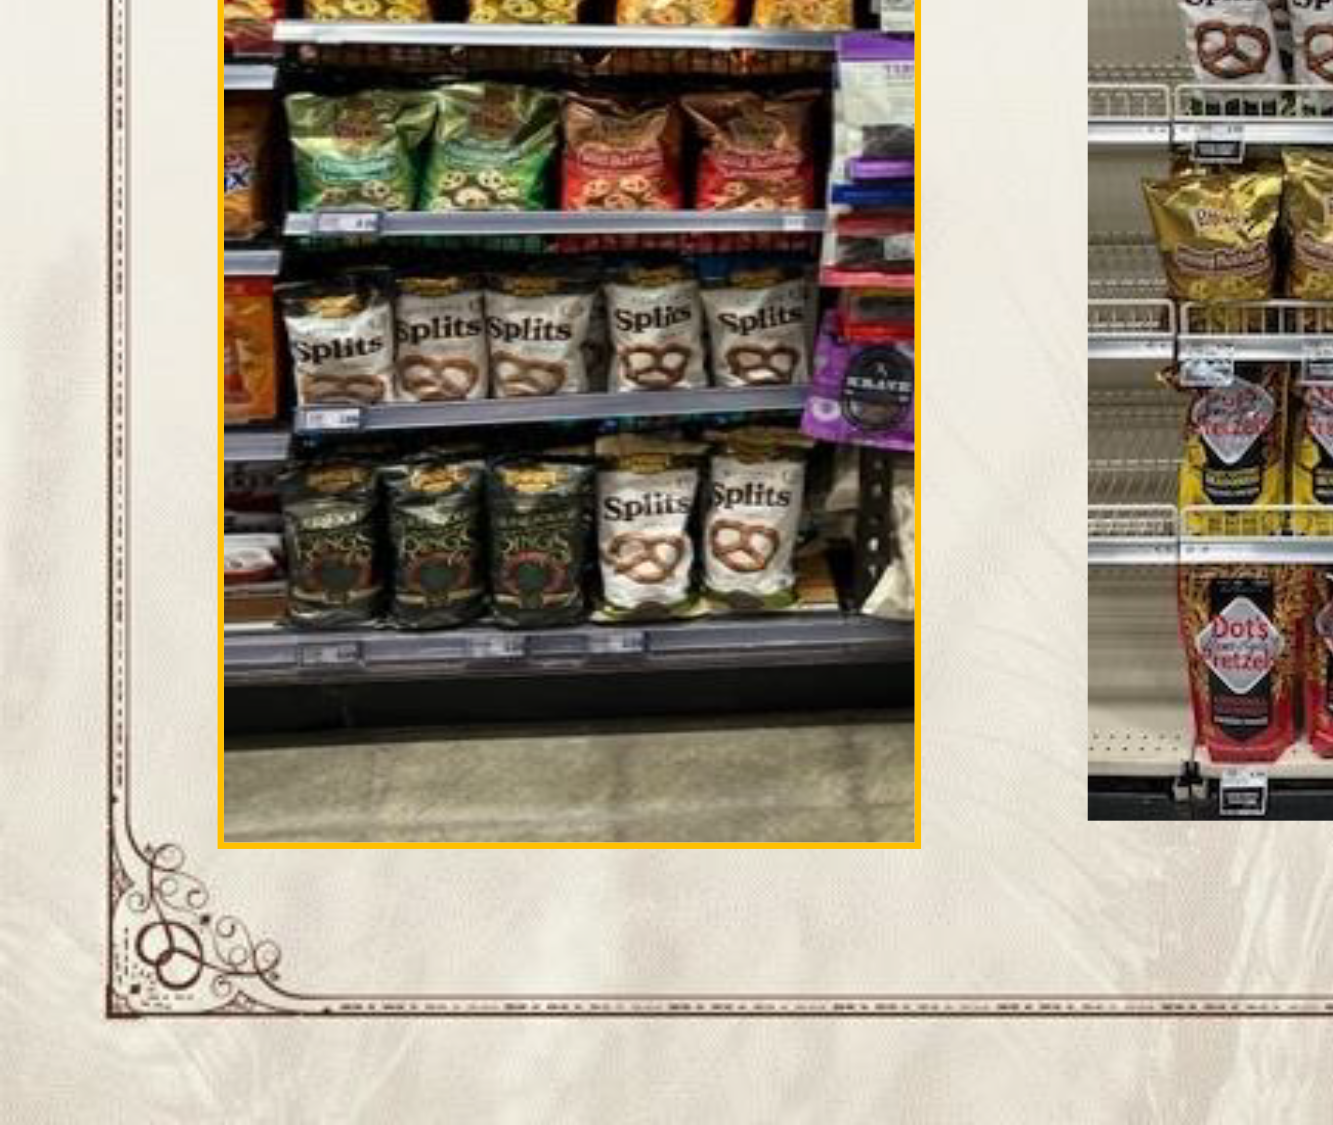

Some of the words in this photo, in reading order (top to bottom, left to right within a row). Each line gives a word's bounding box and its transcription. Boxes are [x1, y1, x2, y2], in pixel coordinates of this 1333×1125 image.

[396, 315, 481, 343] Splits
[486, 316, 572, 342] Splits
[720, 305, 802, 335] Splits
[298, 337, 382, 364] Splits
[604, 492, 689, 521] Splits
[713, 481, 792, 510] Splits
[1212, 615, 1269, 638] Dot's
